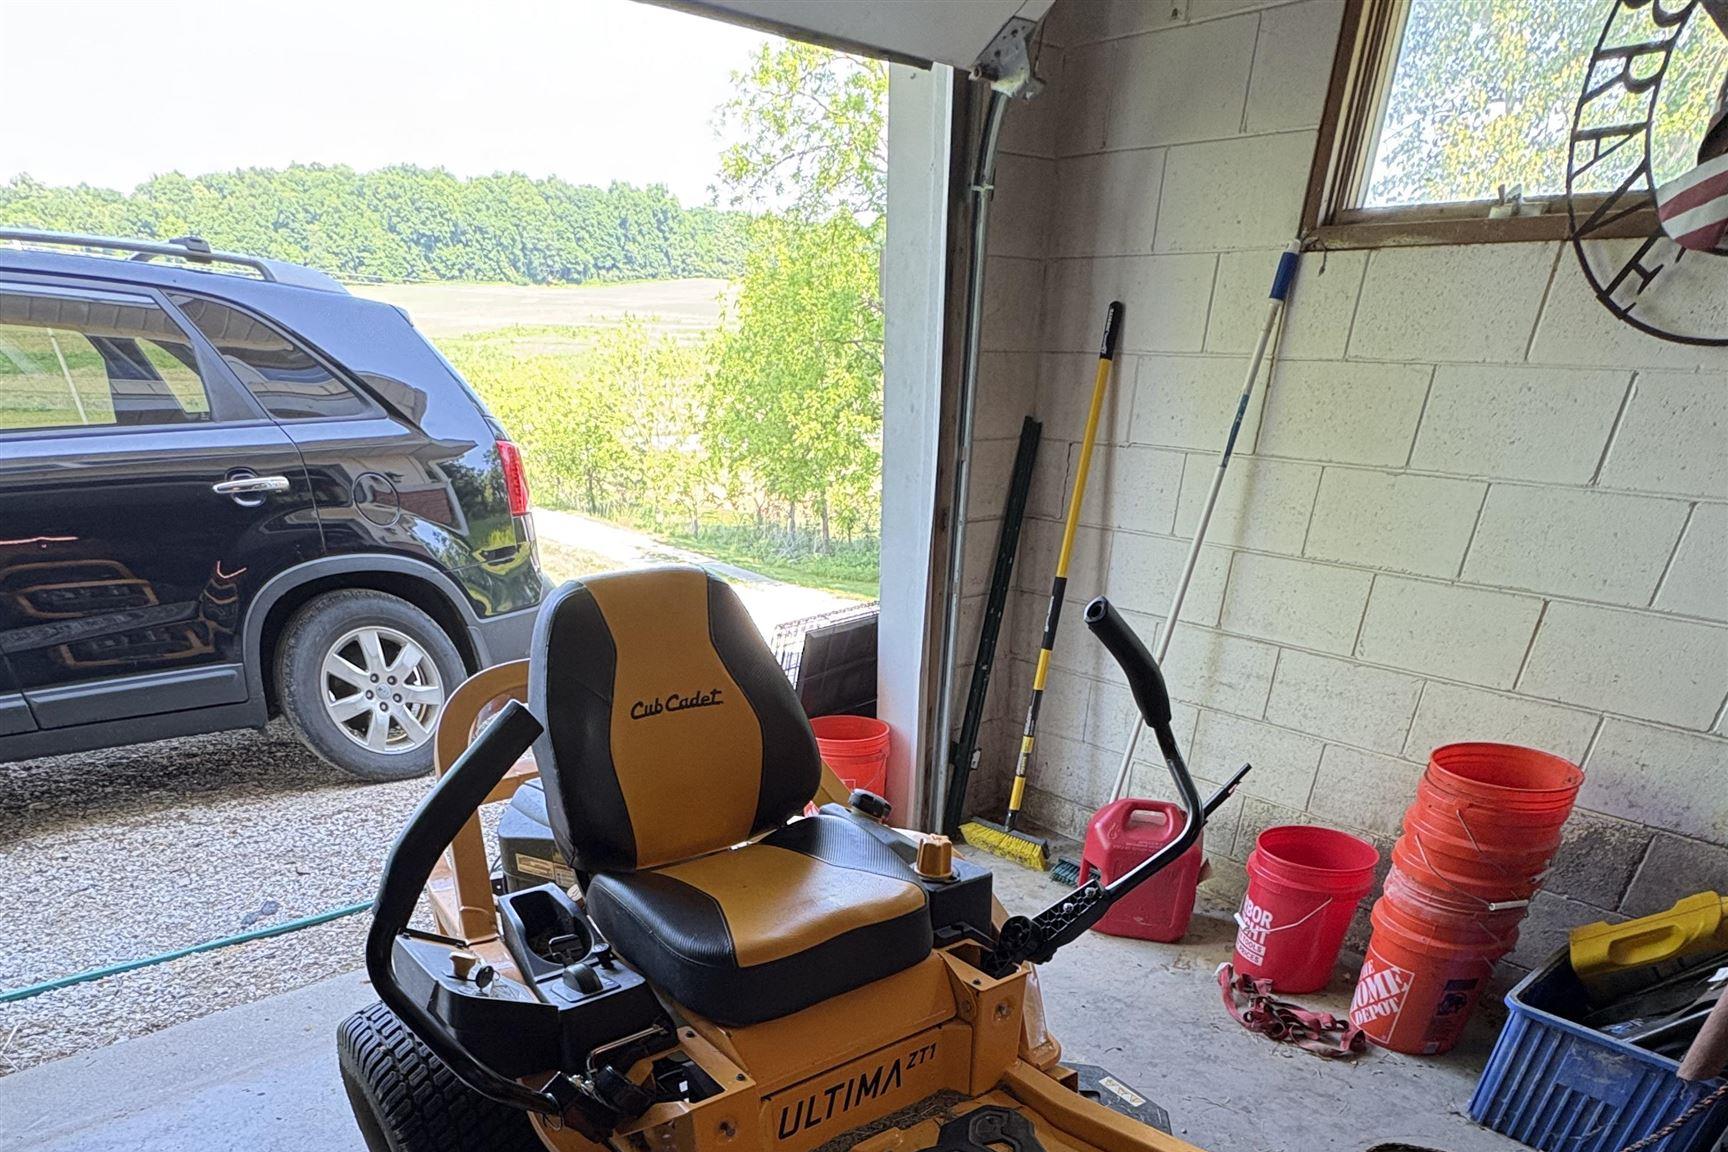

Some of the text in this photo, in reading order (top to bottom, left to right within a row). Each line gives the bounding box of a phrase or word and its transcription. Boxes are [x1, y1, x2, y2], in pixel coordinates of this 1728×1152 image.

[630, 689, 724, 720] Cub Cadet
[1354, 997, 1400, 1026] DEPOT
[777, 1042, 937, 1141] ULTIMA ZT1
